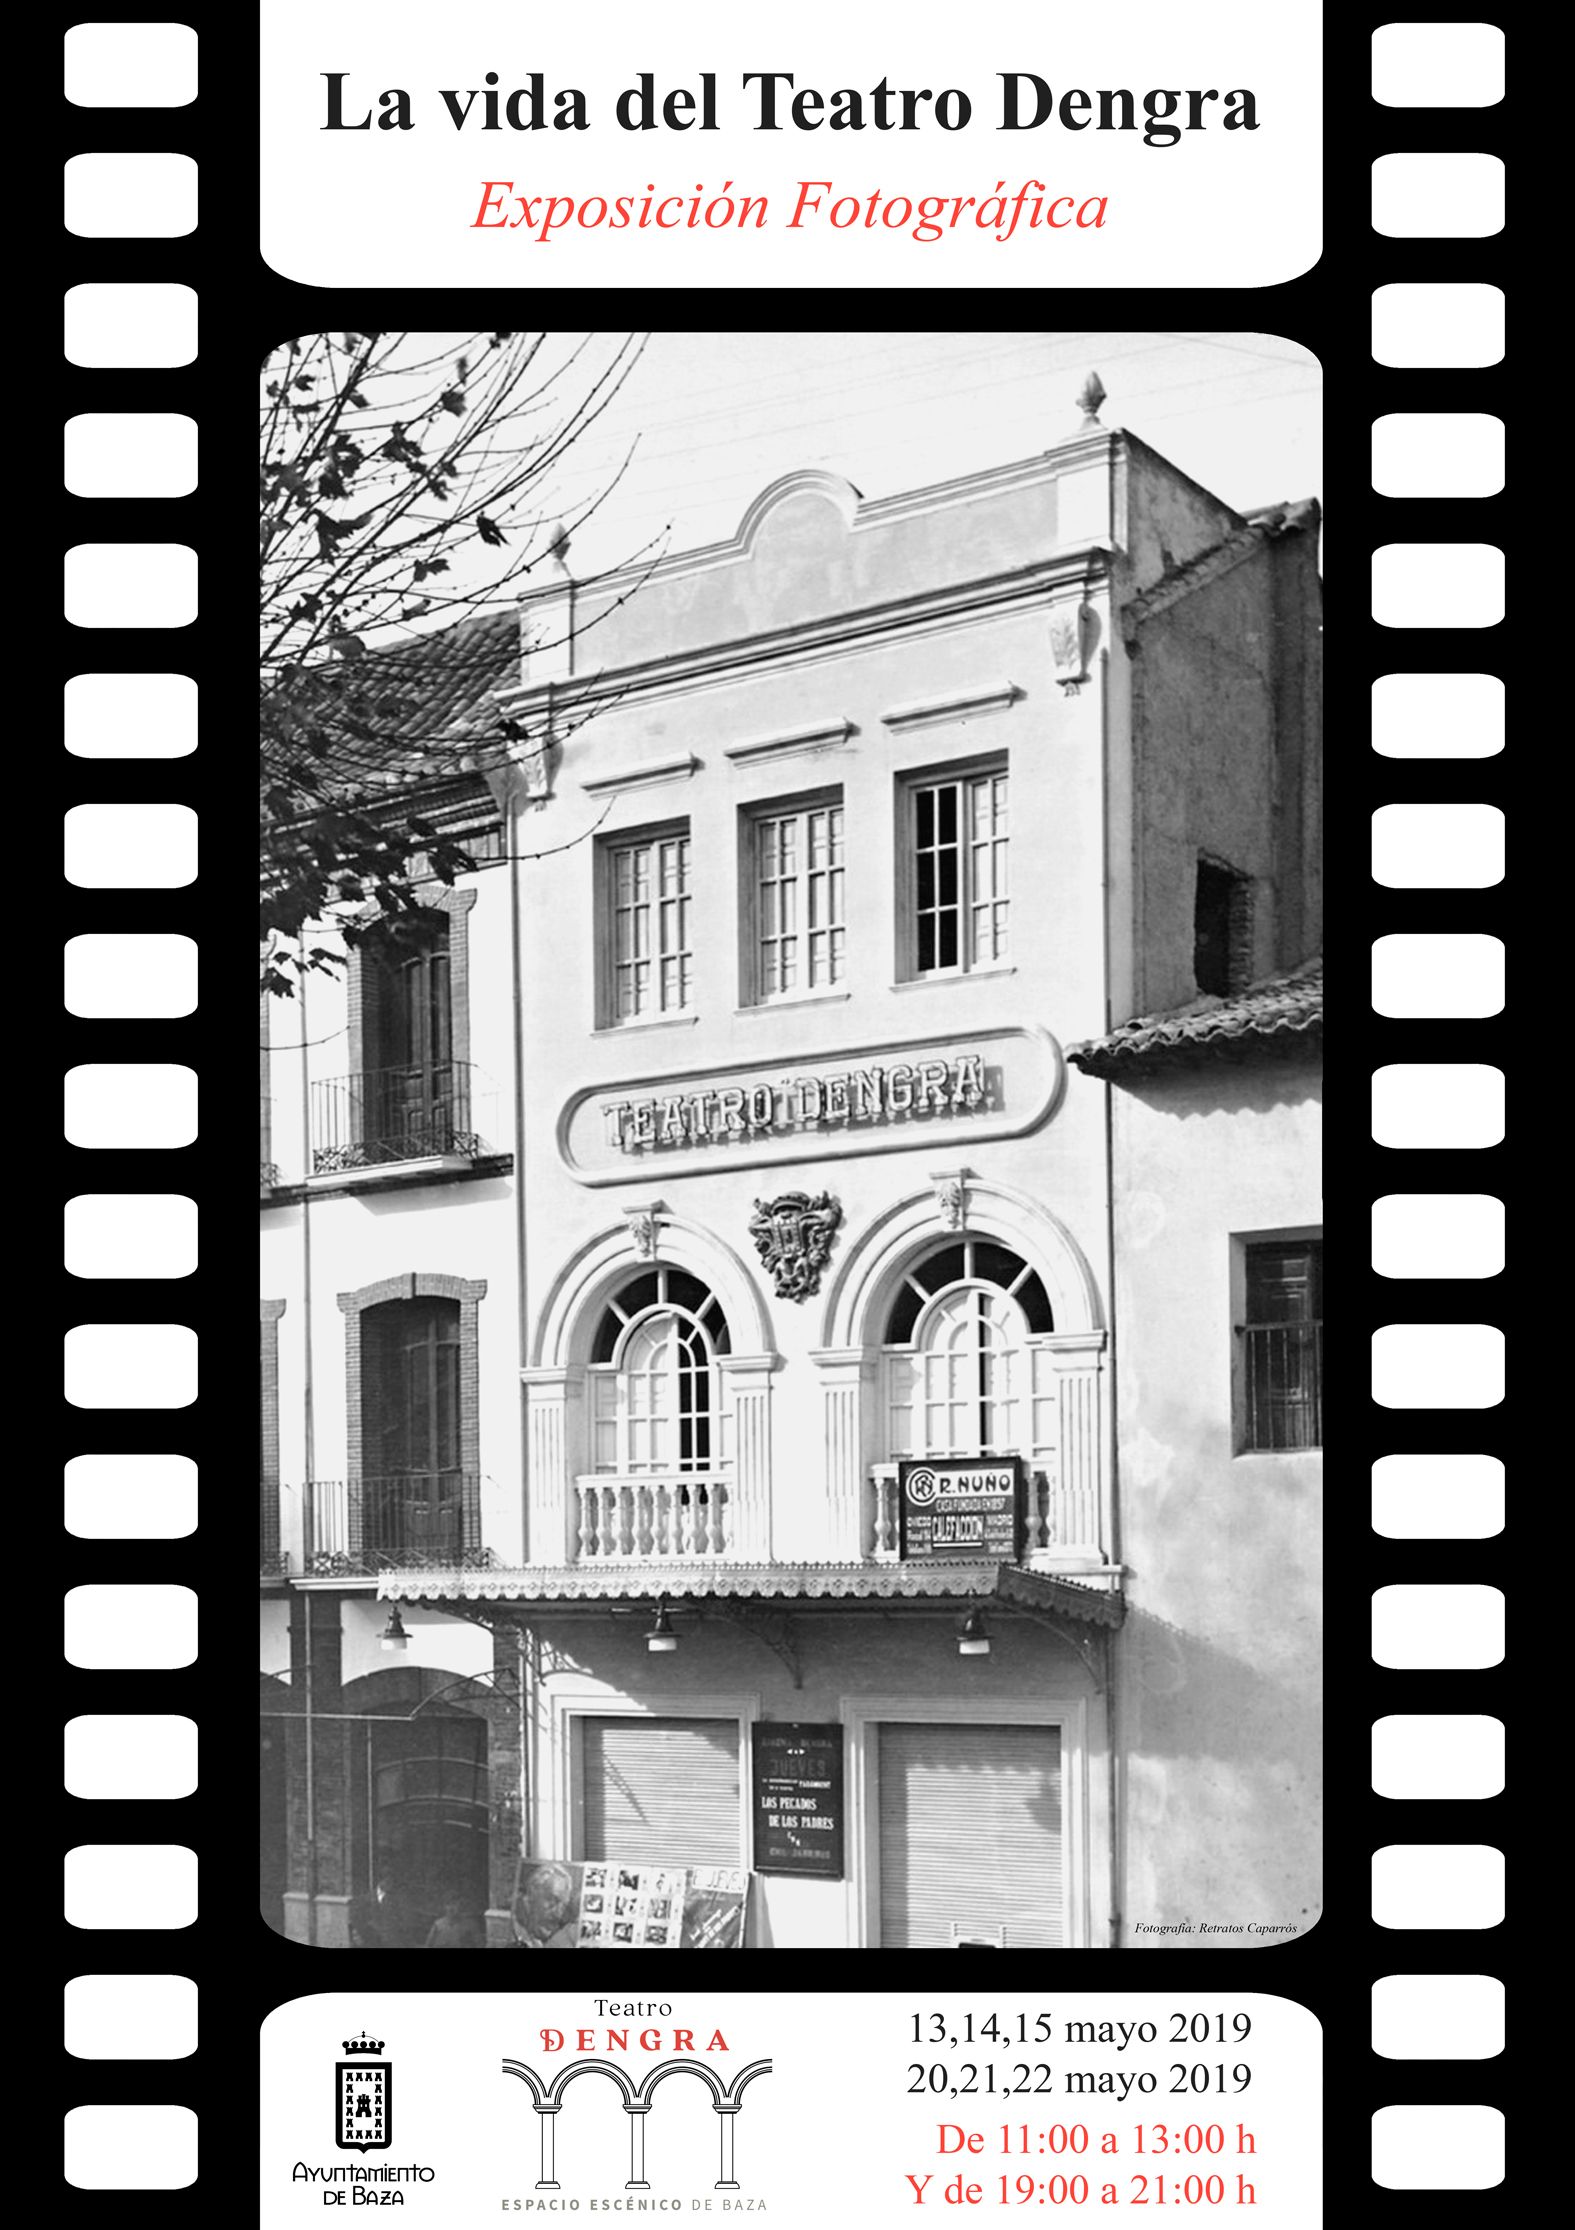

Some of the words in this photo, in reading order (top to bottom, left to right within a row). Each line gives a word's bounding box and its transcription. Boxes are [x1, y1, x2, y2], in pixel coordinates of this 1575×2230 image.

[319, 72, 415, 131] La
[438, 71, 590, 131] vida
[615, 72, 720, 131] del
[742, 72, 972, 131] Teatro
[995, 72, 1261, 148] Dengra
[469, 180, 769, 243] Exposición
[786, 179, 1109, 243] Fotográfica
[602, 1084, 774, 1148] TEATRO
[793, 1054, 986, 1124] DENGRA
[761, 1796, 778, 1809] LOS
[779, 1797, 818, 1811] PECADOS
[768, 1814, 780, 1828] DE
[781, 1815, 799, 1829] LOS
[801, 1816, 835, 1831] PADRES
[593, 1999, 672, 2017] Teatro
[539, 2028, 730, 2052] DENGRA
[911, 2012, 1052, 2049] 13,14,15
[1064, 2021, 1158, 2052] mayo
[1168, 2012, 1252, 2043] 2019
[906, 2063, 1053, 2100] 20,21,22
[1064, 2072, 1158, 2102] mayo
[1168, 2063, 1252, 2094] 2019
[936, 2124, 985, 2154] De
[1000, 2124, 1089, 2154] 11:00
[1101, 2133, 1120, 2154] a
[1134, 2123, 1225, 2154] 13:00
[1236, 2123, 1258, 2154] h
[502, 2199, 580, 2211] ESPACIO
[590, 2195, 682, 2211] ESCÉNICO
[692, 2199, 712, 2211] DE
[723, 2199, 767, 2211] BAZA
[904, 2174, 935, 2205] Y
[944, 2173, 983, 2205] de
[998, 2174, 1089, 2205] 19:00
[1101, 2183, 1120, 2205] a
[1129, 2174, 1225, 2205] 21:00
[1235, 2173, 1257, 2205] h
